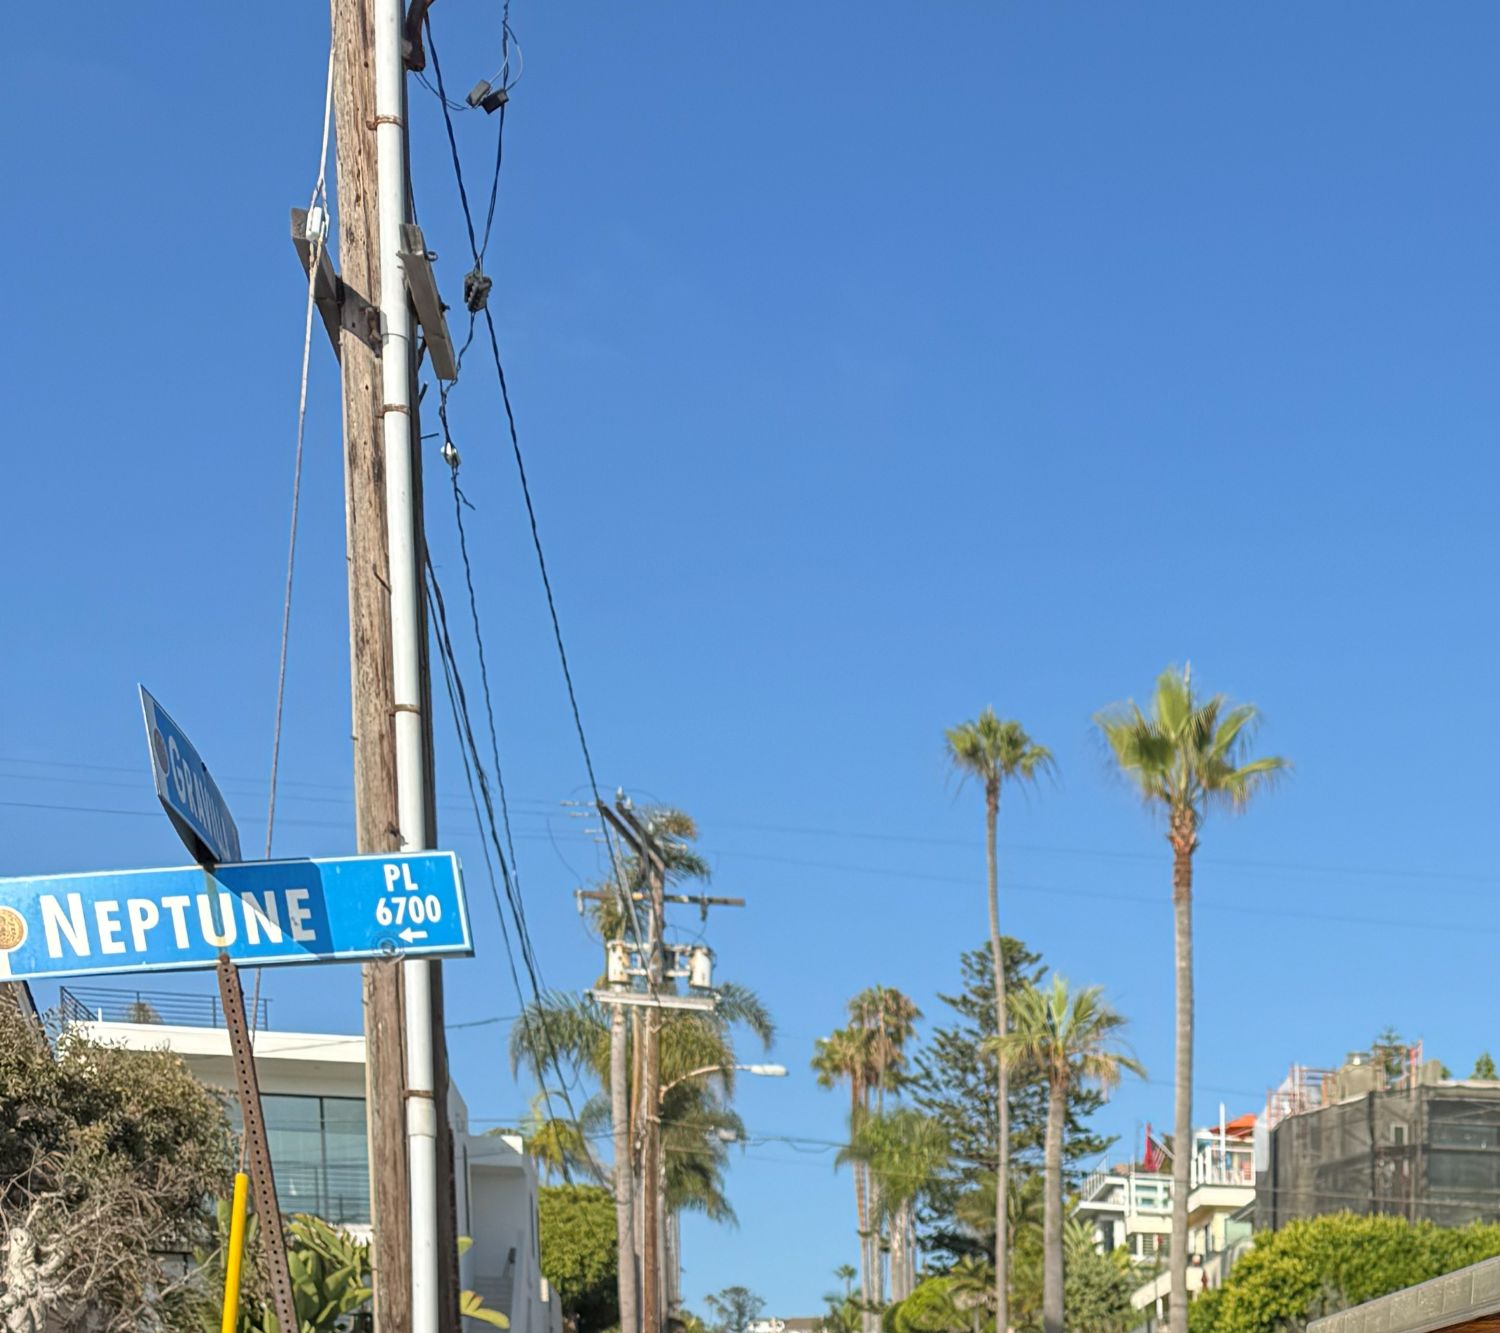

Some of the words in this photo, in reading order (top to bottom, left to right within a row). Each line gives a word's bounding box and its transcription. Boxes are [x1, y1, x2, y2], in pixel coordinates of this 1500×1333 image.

[383, 863, 419, 892] PL
[40, 888, 318, 960] NEPTUNE
[376, 894, 442, 926] 6700
